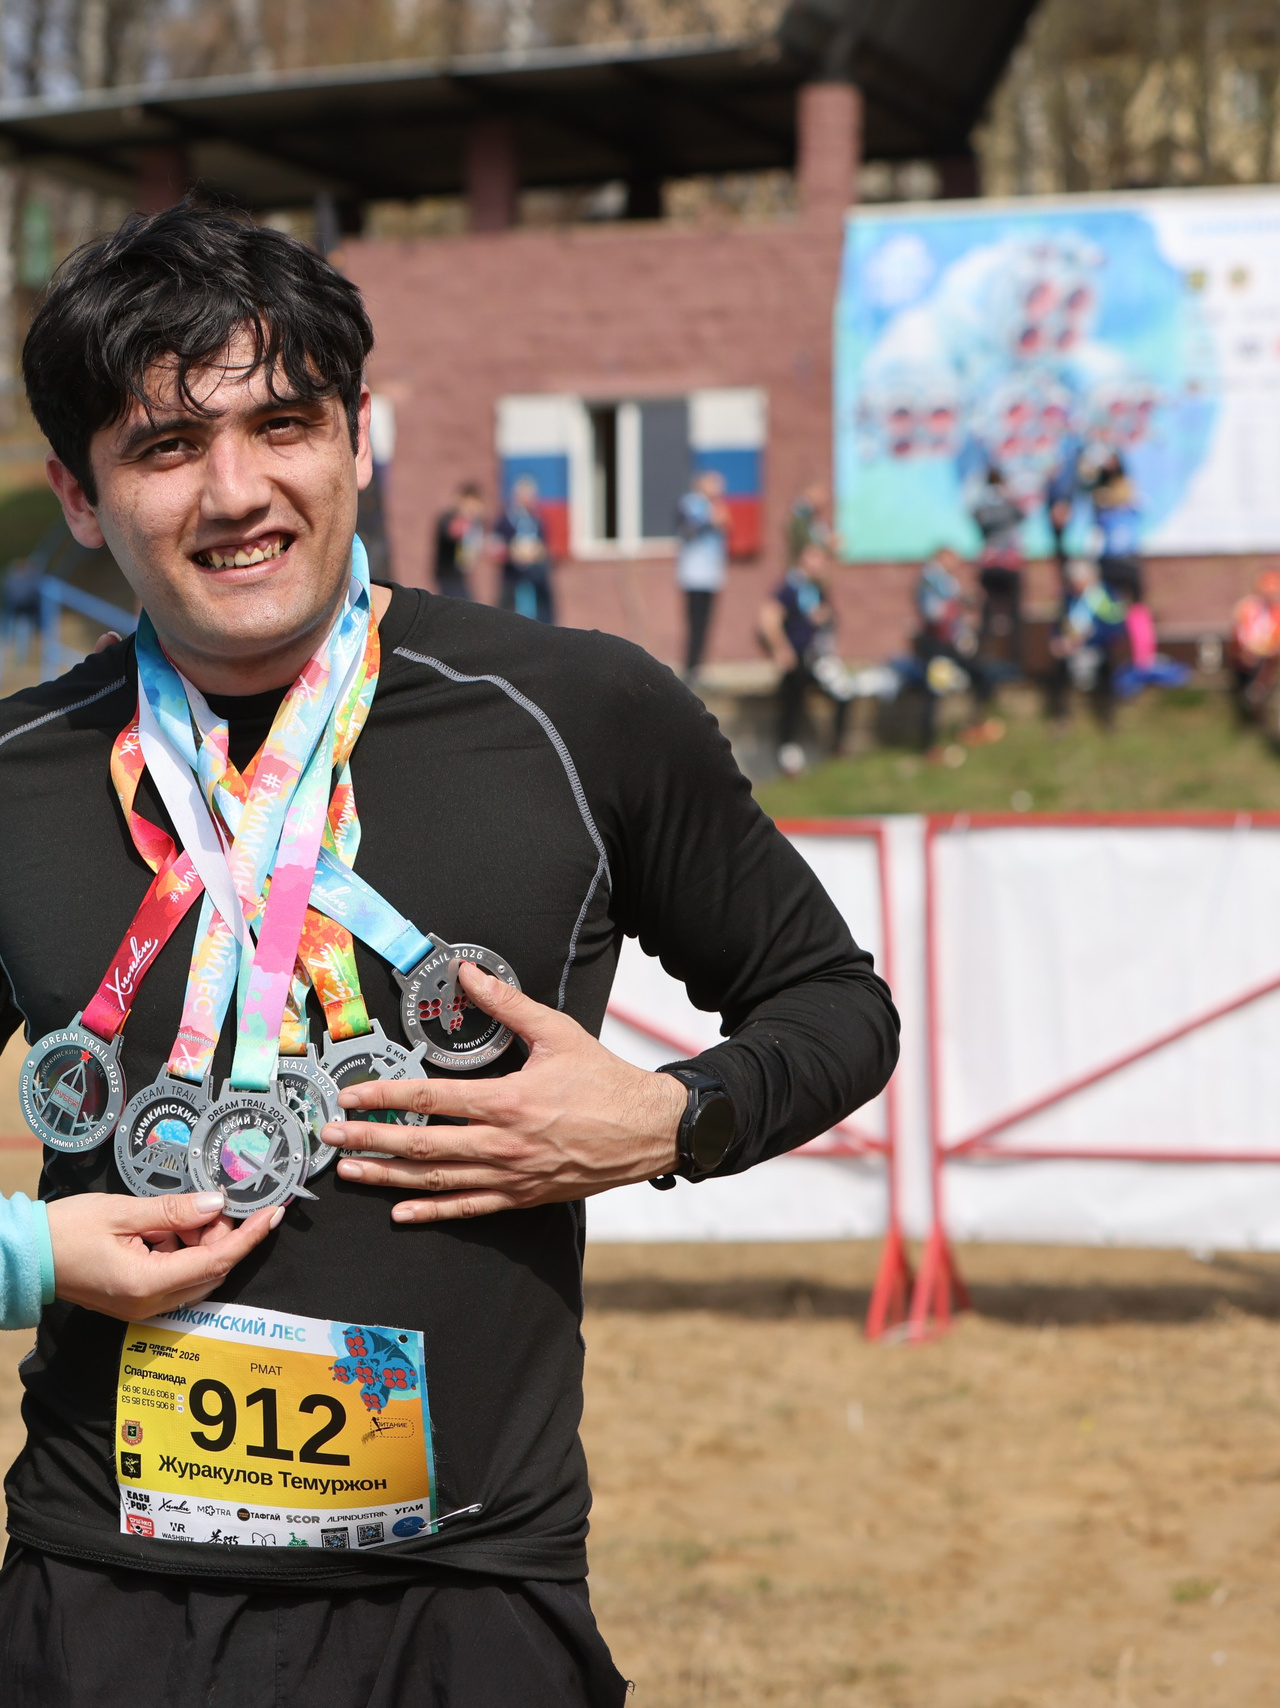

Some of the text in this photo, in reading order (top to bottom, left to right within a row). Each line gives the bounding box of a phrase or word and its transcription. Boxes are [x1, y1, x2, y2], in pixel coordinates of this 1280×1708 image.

[406, 948, 484, 1026] DREAM TRAIL 2026
[385, 1044, 393, 1053] 6
[41, 1032, 120, 1094] DREAM TRAIL 2025
[431, 1051, 486, 1066] СПАРТАКИАДА
[311, 1070, 334, 1097] 2024
[129, 1085, 197, 1113] DREAM TRAIL
[22, 1074, 40, 1130] СПАРТАКИАДА
[49, 1137, 74, 1149] ХИМКИ
[76, 1124, 108, 1148] 13.04.2025
[207, 1100, 239, 1122] DREAM
[241, 1099, 267, 1111] TRAIL
[268, 1106, 288, 1125] 2021
[134, 1103, 200, 1147] ХИМКИНСКИЙ
[253, 1118, 275, 1134] ЛЕС
[156, 1308, 307, 1343] ИМКИНСКИЙ ЛЕС
[148, 1342, 178, 1354] DREAM
[151, 1349, 201, 1362] TRAIL 2026
[124, 1364, 187, 1386] Спартакиада
[250, 1362, 284, 1376] РМАТ
[142, 1387, 156, 1397] 978
[156, 1389, 170, 1399] 903
[169, 1392, 175, 1401] 8
[141, 1398, 155, 1408] 513
[155, 1400, 169, 1410] 905
[169, 1402, 175, 1411] 8
[189, 1378, 351, 1467] 912
[158, 1454, 388, 1495] Журакулов Темуржон
[126, 1490, 150, 1503] EASY
[130, 1501, 148, 1512] POP
[394, 1503, 424, 1515] УГЛИ
[250, 1512, 281, 1521] ТАФГАЙ
[286, 1514, 320, 1524] SCOR
[326, 1511, 388, 1523] ALPINDUSTRIA
